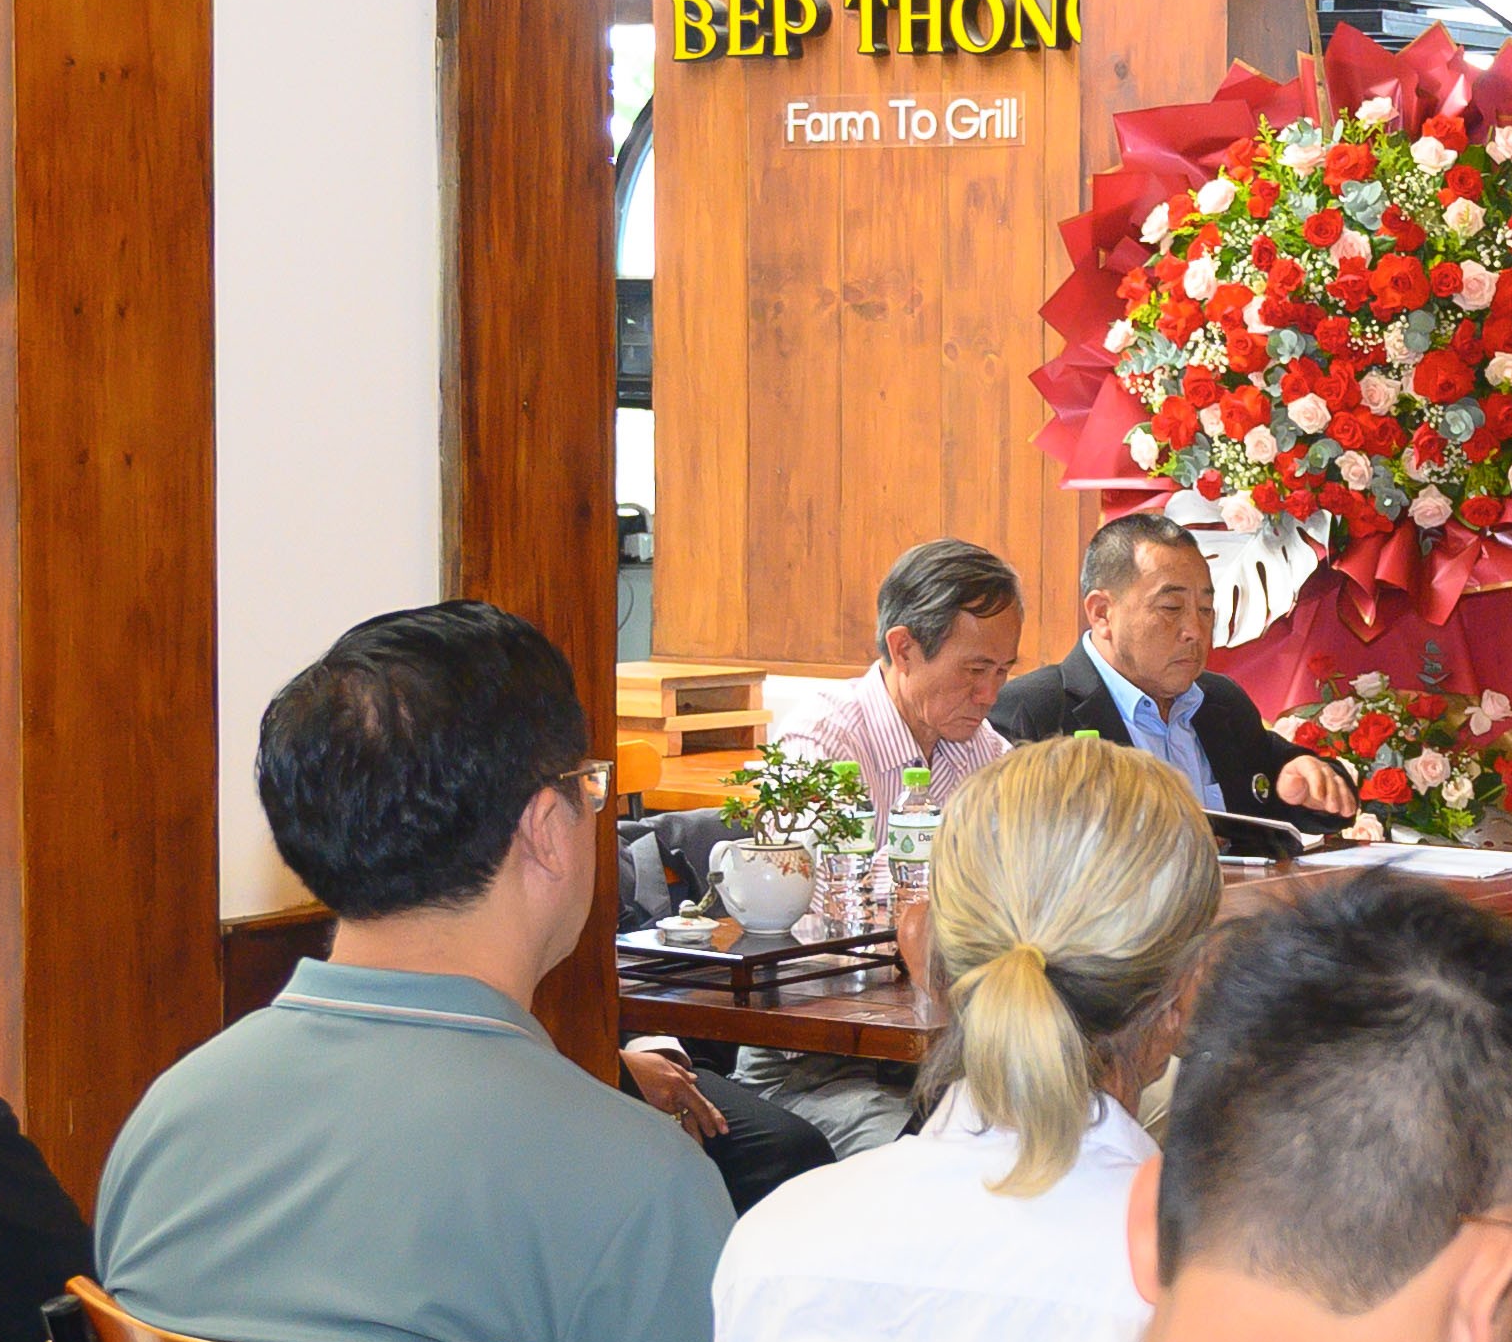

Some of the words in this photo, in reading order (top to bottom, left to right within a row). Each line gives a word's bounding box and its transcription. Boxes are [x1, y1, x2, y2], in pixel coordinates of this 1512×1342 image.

[787, 101, 880, 143] Farm
[888, 99, 938, 140] To
[945, 98, 1018, 140] Grill
